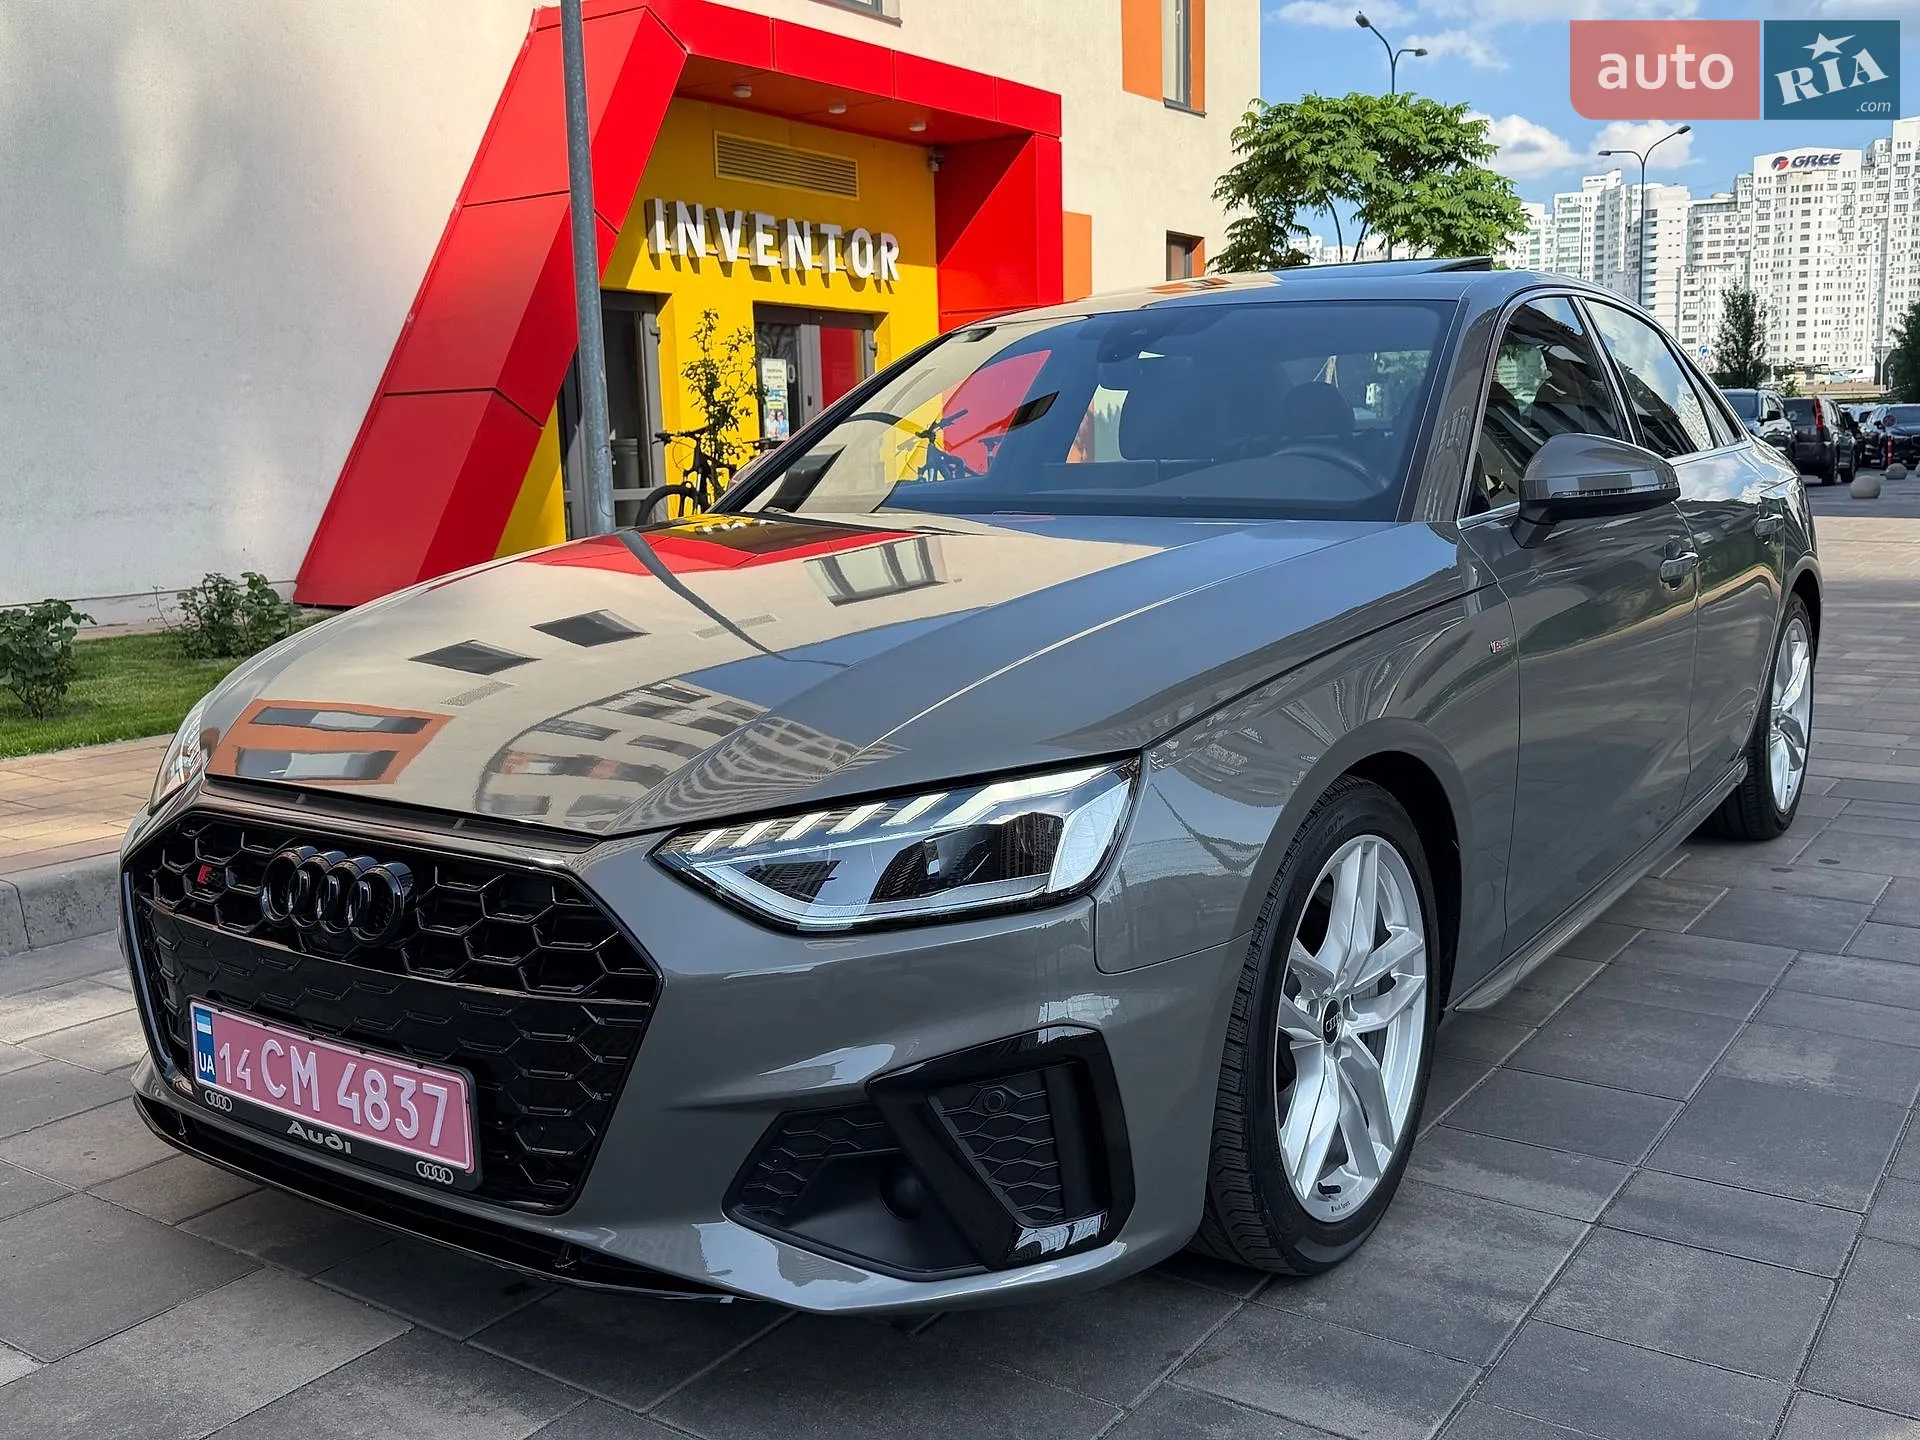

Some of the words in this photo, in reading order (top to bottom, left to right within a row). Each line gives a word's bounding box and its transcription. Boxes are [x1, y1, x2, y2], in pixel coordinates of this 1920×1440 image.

[1791, 152, 1843, 168] GREE
[645, 198, 900, 281] INVENTOR
[198, 1051, 216, 1076] UA
[219, 1042, 253, 1092] 14
[260, 1039, 321, 1113] CM
[336, 1062, 449, 1148] 4837
[286, 1120, 353, 1155] Audi
